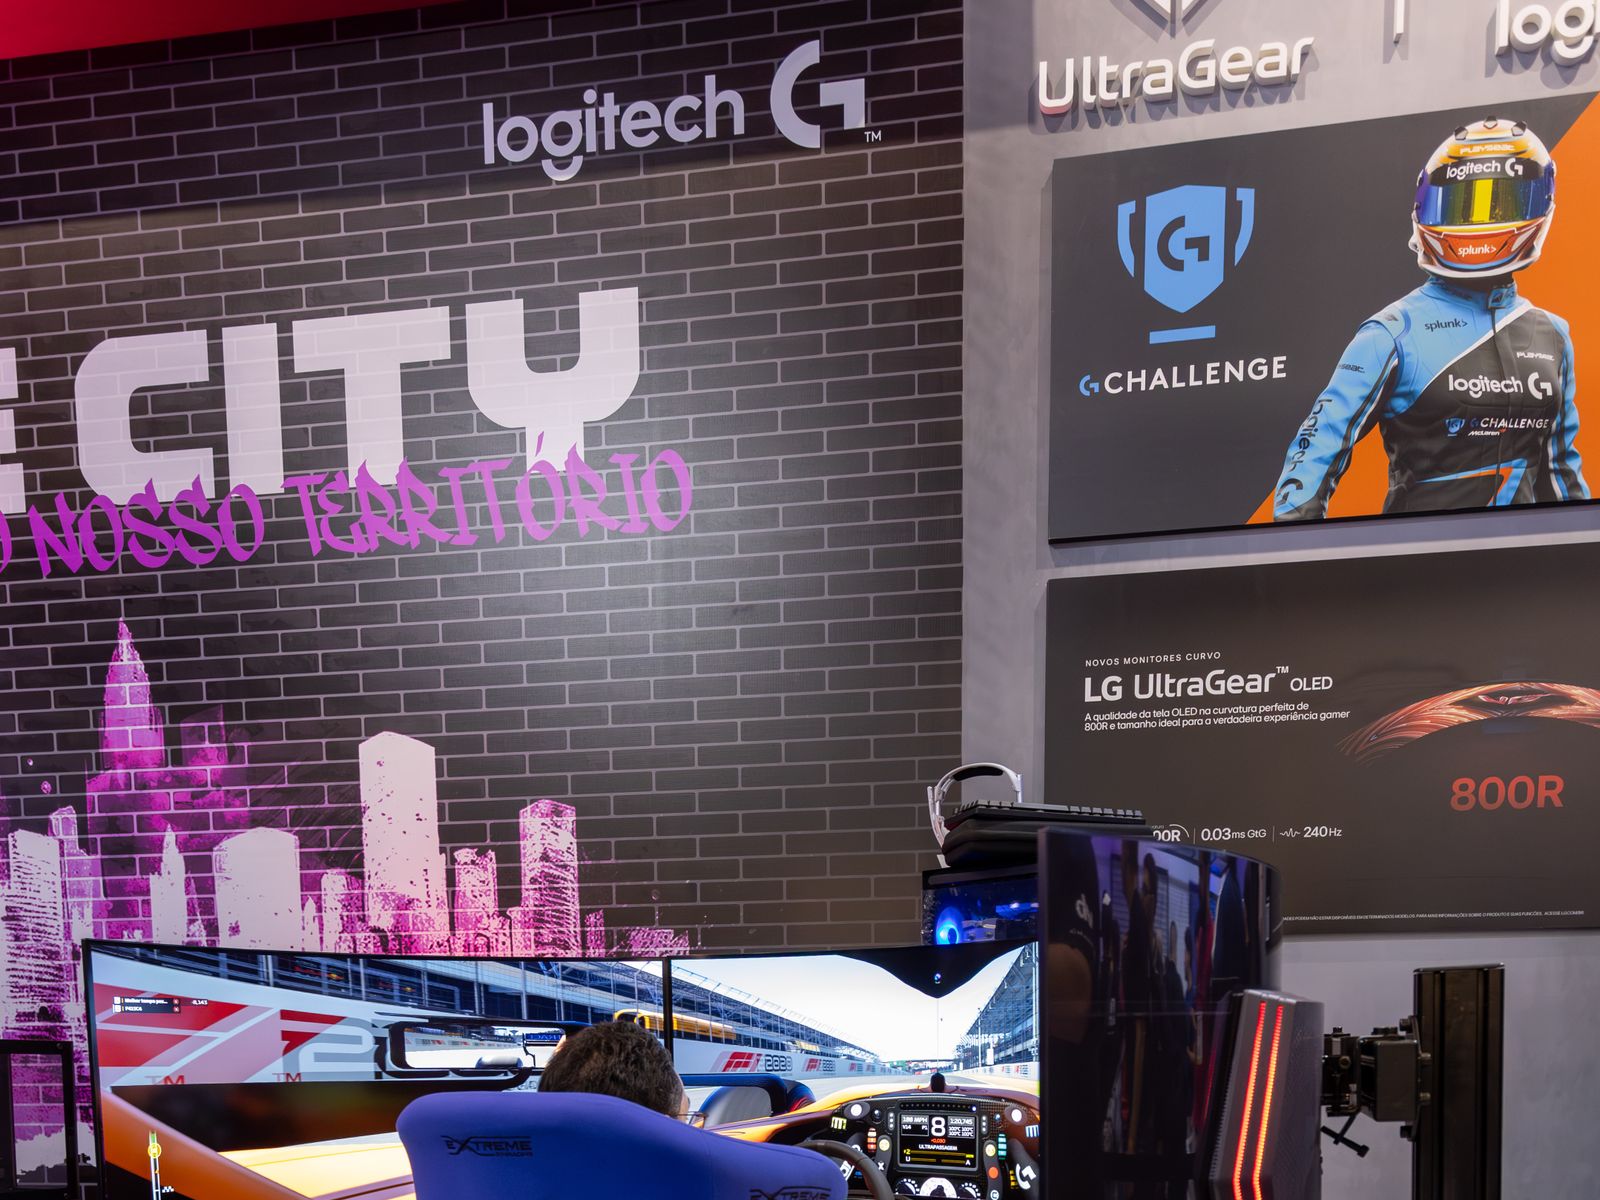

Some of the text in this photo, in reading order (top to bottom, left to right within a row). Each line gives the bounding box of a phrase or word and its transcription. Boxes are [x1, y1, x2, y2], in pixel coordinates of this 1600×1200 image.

[1037, 37, 1314, 113] UltraGear
[483, 75, 745, 181] logitech
[1446, 160, 1501, 181] logitech
[1103, 355, 1288, 395] CHALLENGE
[1448, 374, 1524, 399] logitech
[74, 287, 640, 506] CITY
[1480, 417, 1550, 429] CHALLENGE
[28, 475, 266, 577] NOSSO
[280, 431, 693, 557] TERRITÓRIO
[1085, 651, 1222, 668] NOVOS MONITORES CURVO
[1084, 675, 1123, 703] LG
[1290, 676, 1333, 692] OLED
[1084, 701, 1310, 723] A qualidade da tela OLED na curvatura perfeita de
[1084, 710, 1351, 732] 800R e tamanho ideal para a verdadeira experiência gamer
[1450, 774, 1565, 812] 800R
[1152, 829, 1182, 843] 00R
[1247, 829, 1267, 840] GtG
[931, 1116, 946, 1137] 8
